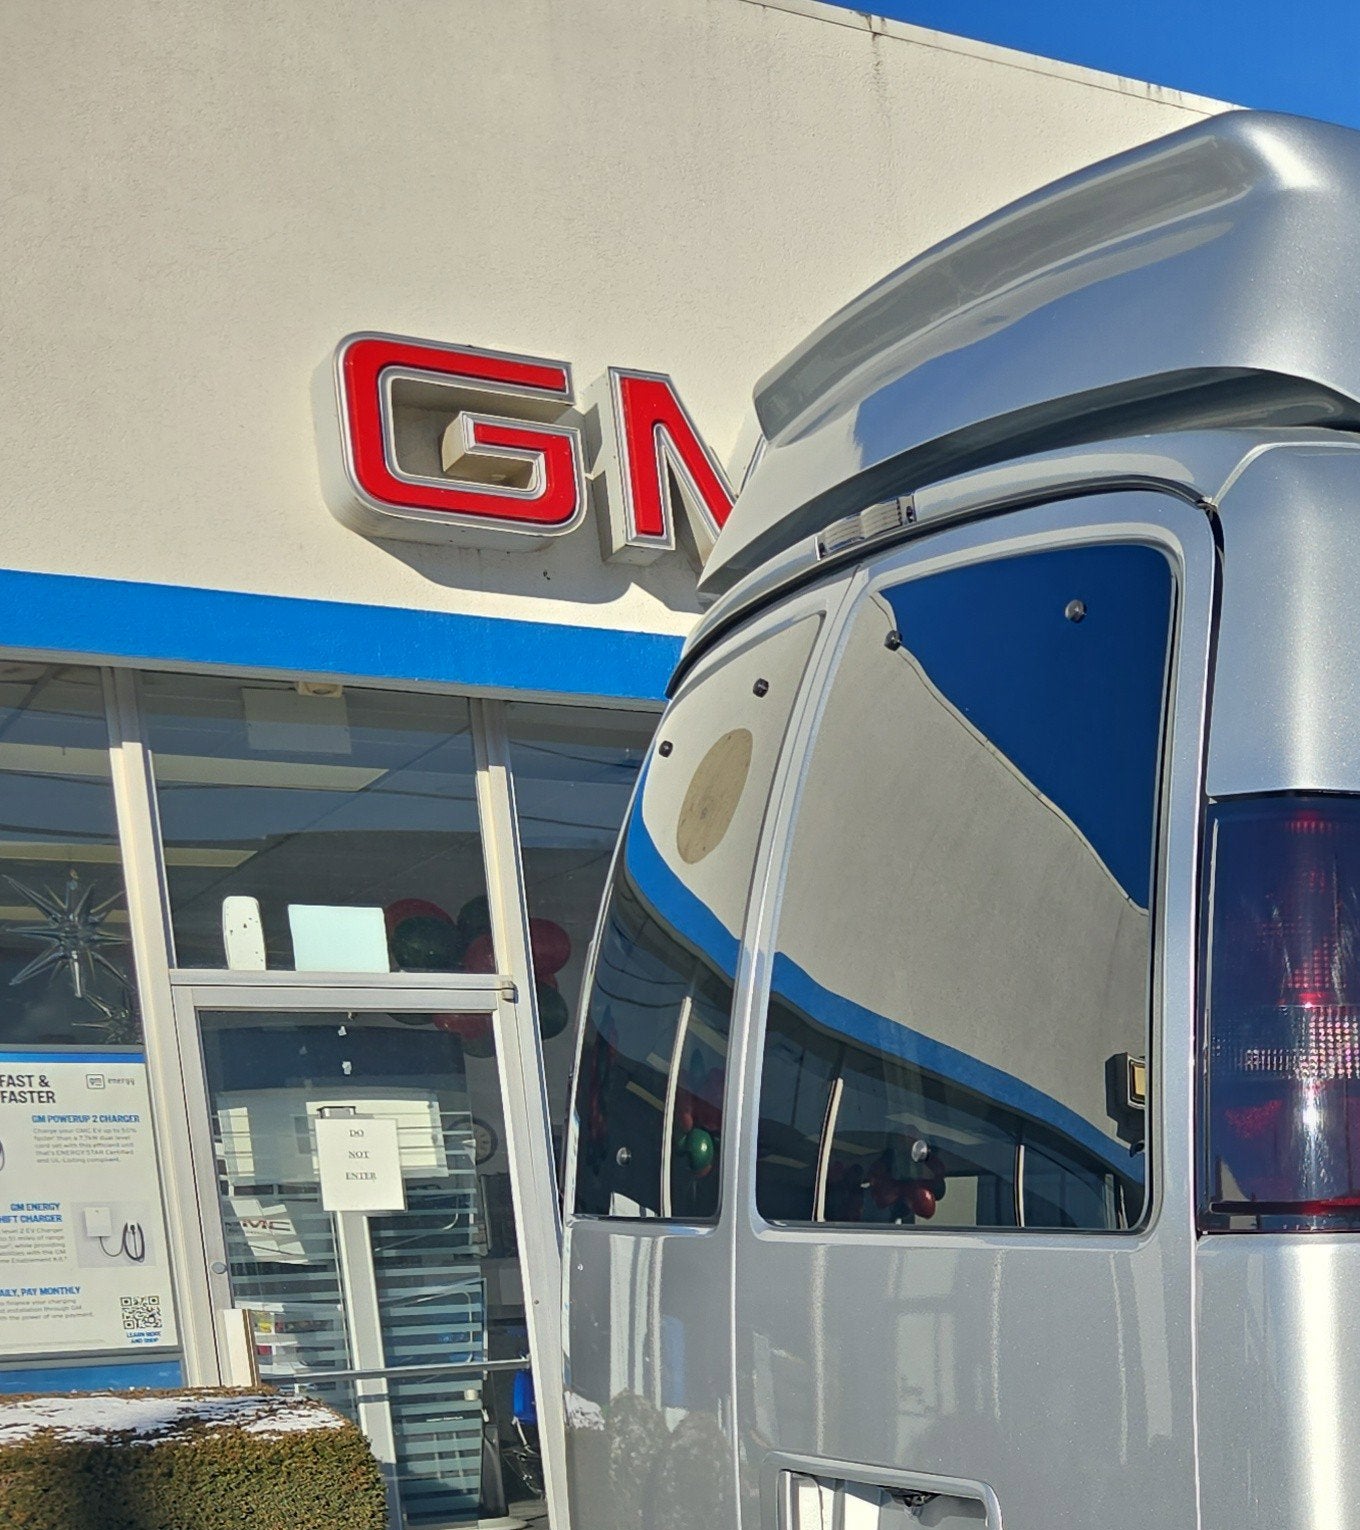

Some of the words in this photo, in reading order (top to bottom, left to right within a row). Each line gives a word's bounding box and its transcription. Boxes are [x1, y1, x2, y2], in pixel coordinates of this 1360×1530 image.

[0, 1074, 35, 1088] FAST
[38, 1074, 51, 1088] &
[0, 1090, 56, 1104] FASTER
[99, 1114, 140, 1123] CHARGER
[349, 1129, 365, 1138] DO
[348, 1150, 370, 1159] NOT
[345, 1171, 377, 1181] ENTER
[21, 1287, 38, 1297] PAY
[39, 1285, 81, 1296] MONTHLY
